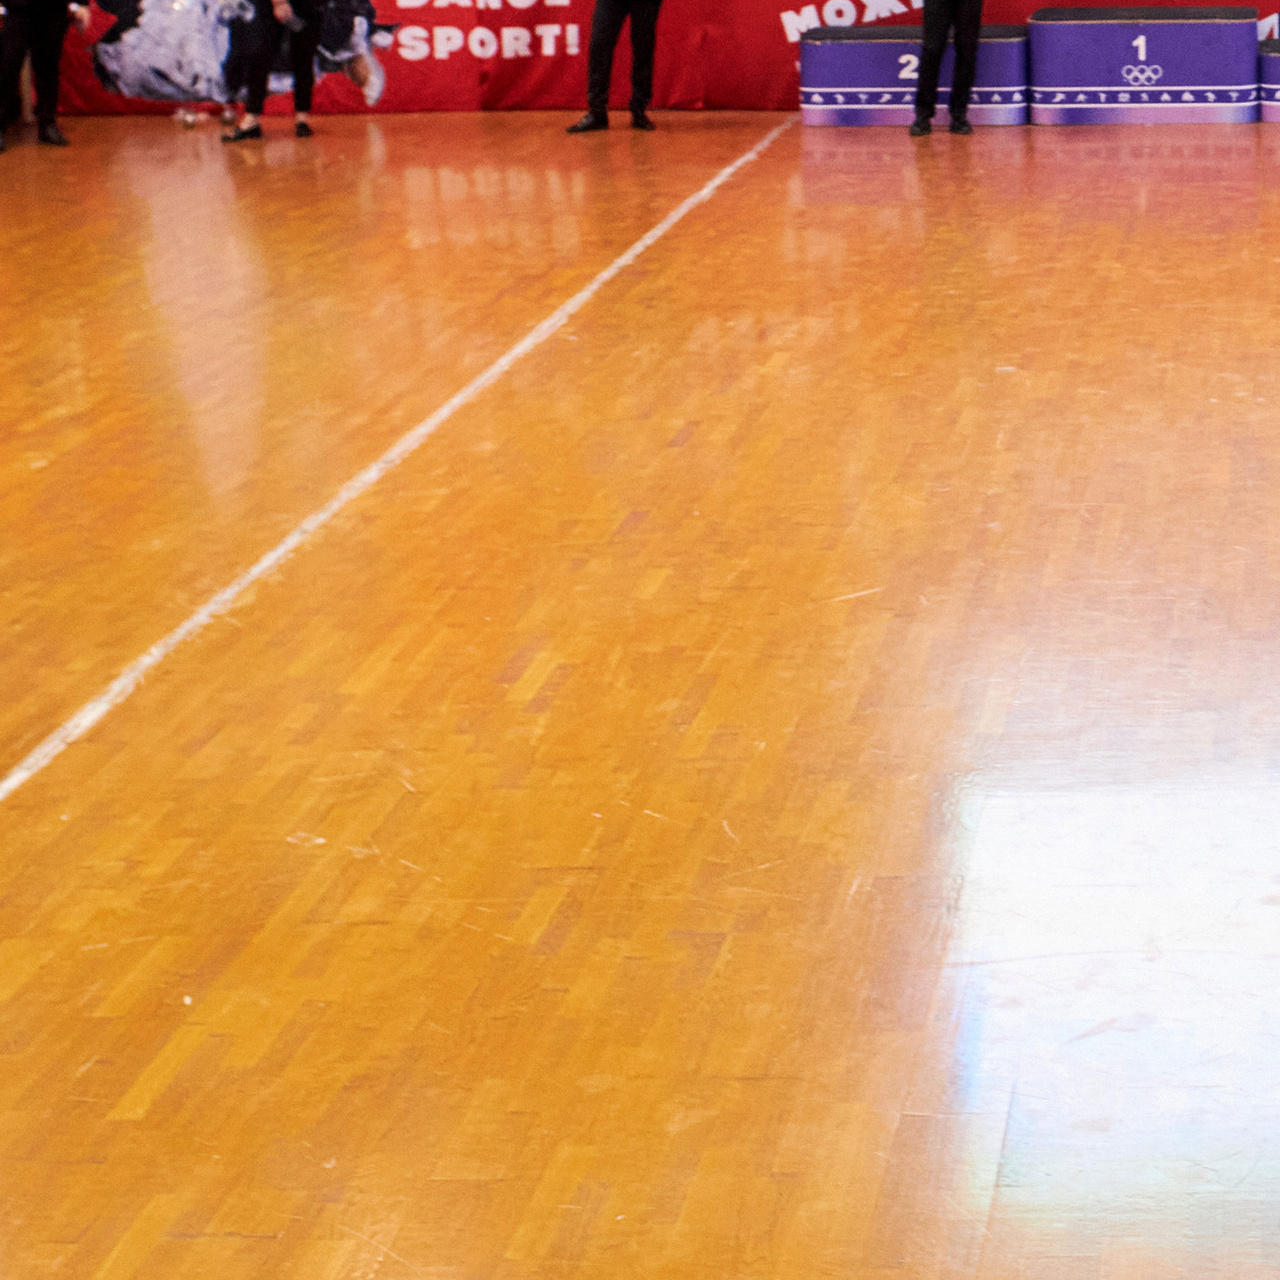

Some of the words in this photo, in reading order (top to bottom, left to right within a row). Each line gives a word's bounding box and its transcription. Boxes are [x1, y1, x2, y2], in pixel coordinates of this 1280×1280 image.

[397, 23, 580, 61] SPORT!
[1132, 35, 1148, 60] 1
[898, 54, 920, 80] 2
